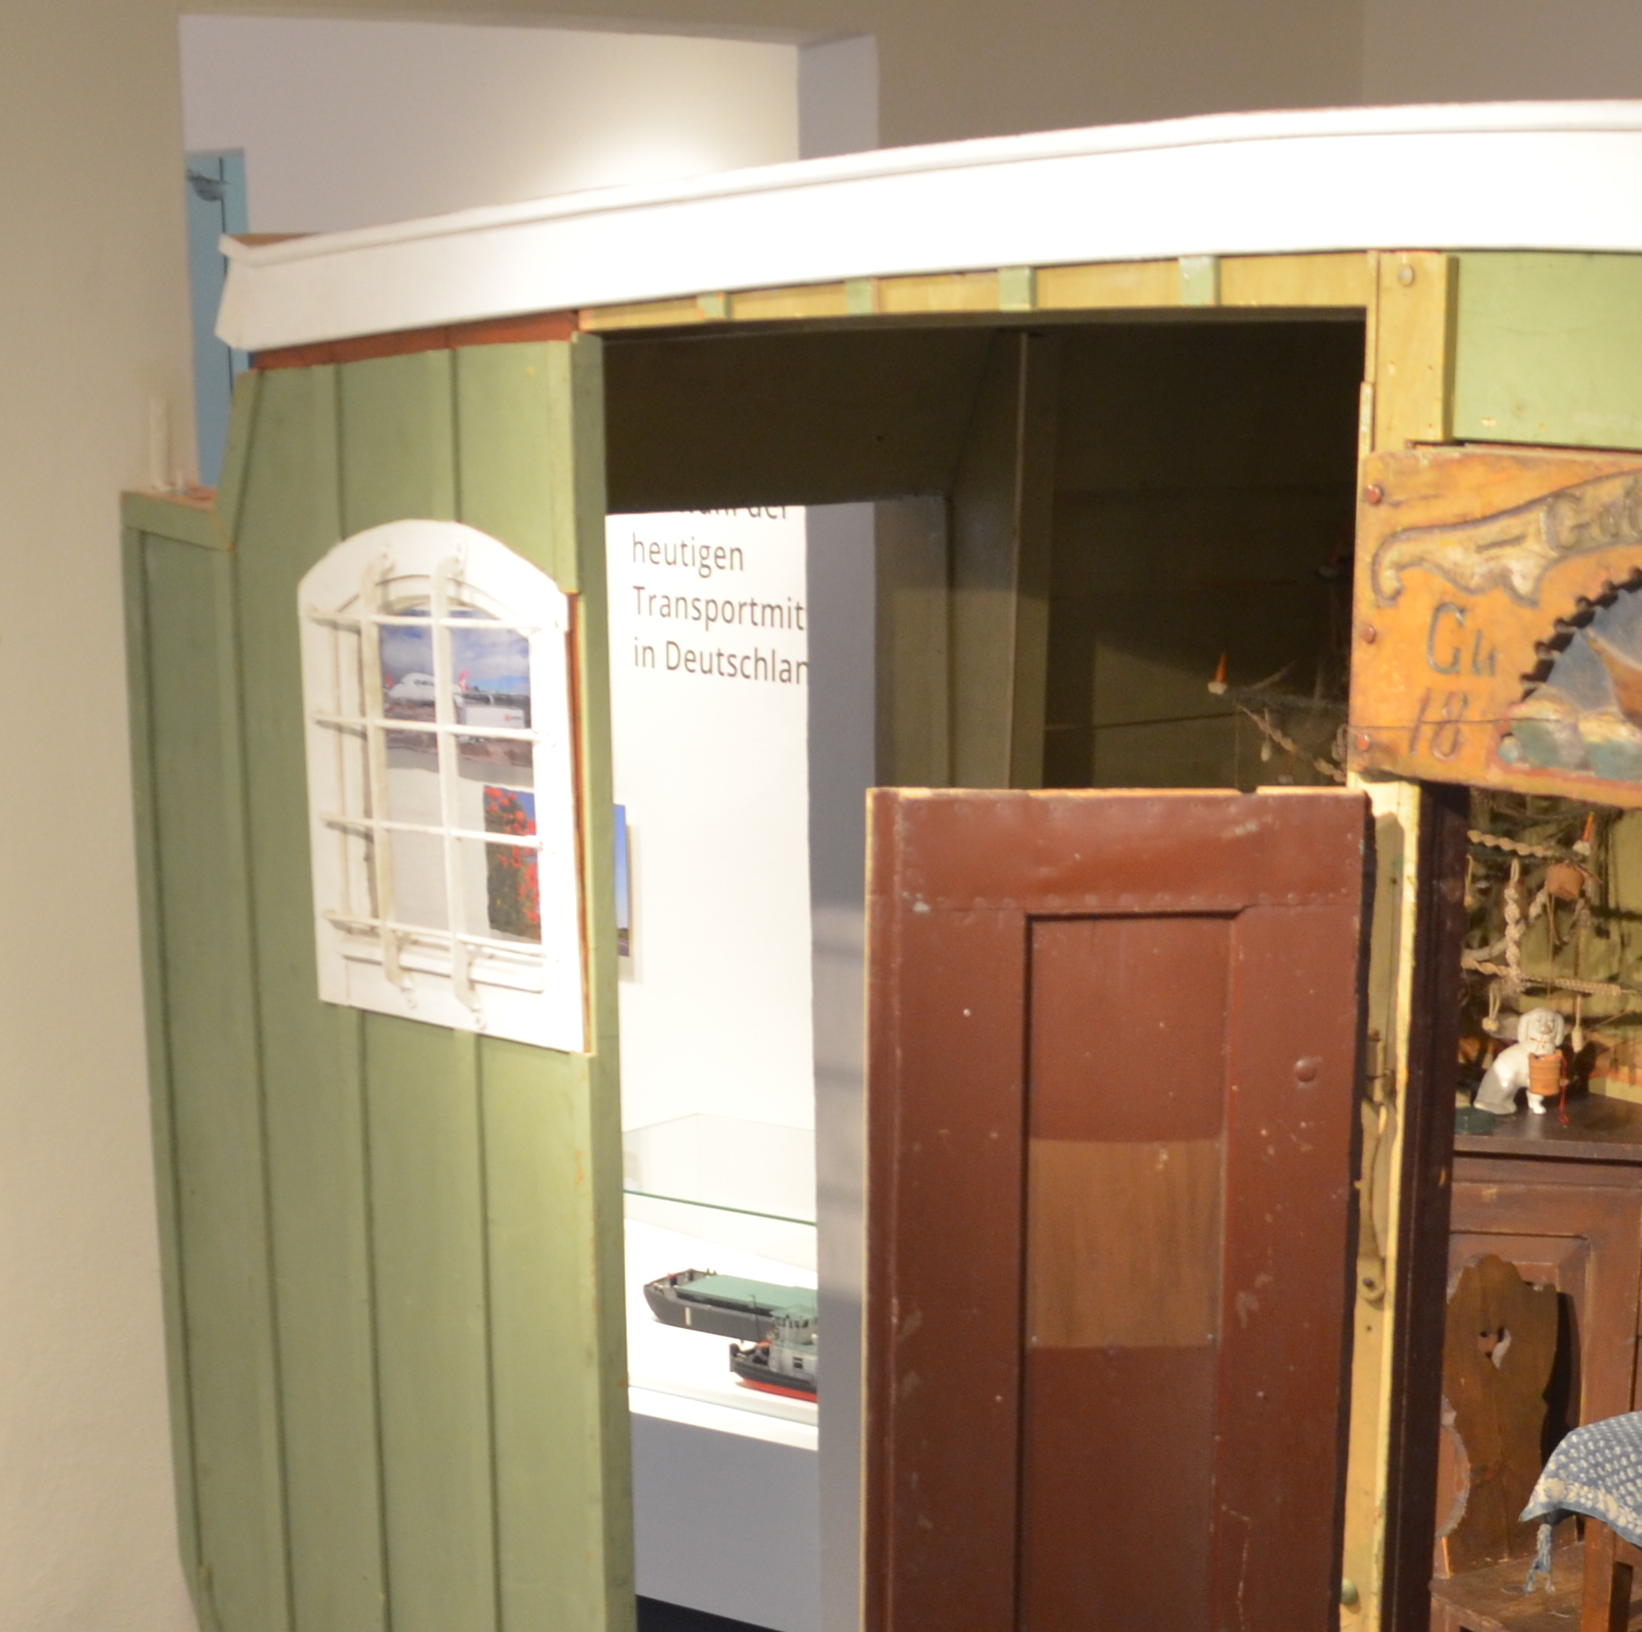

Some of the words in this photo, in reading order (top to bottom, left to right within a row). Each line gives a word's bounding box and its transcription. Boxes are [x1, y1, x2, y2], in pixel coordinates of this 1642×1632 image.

[632, 531, 745, 579] heutigen
[632, 585, 805, 632] Transportmit
[634, 636, 656, 669] in
